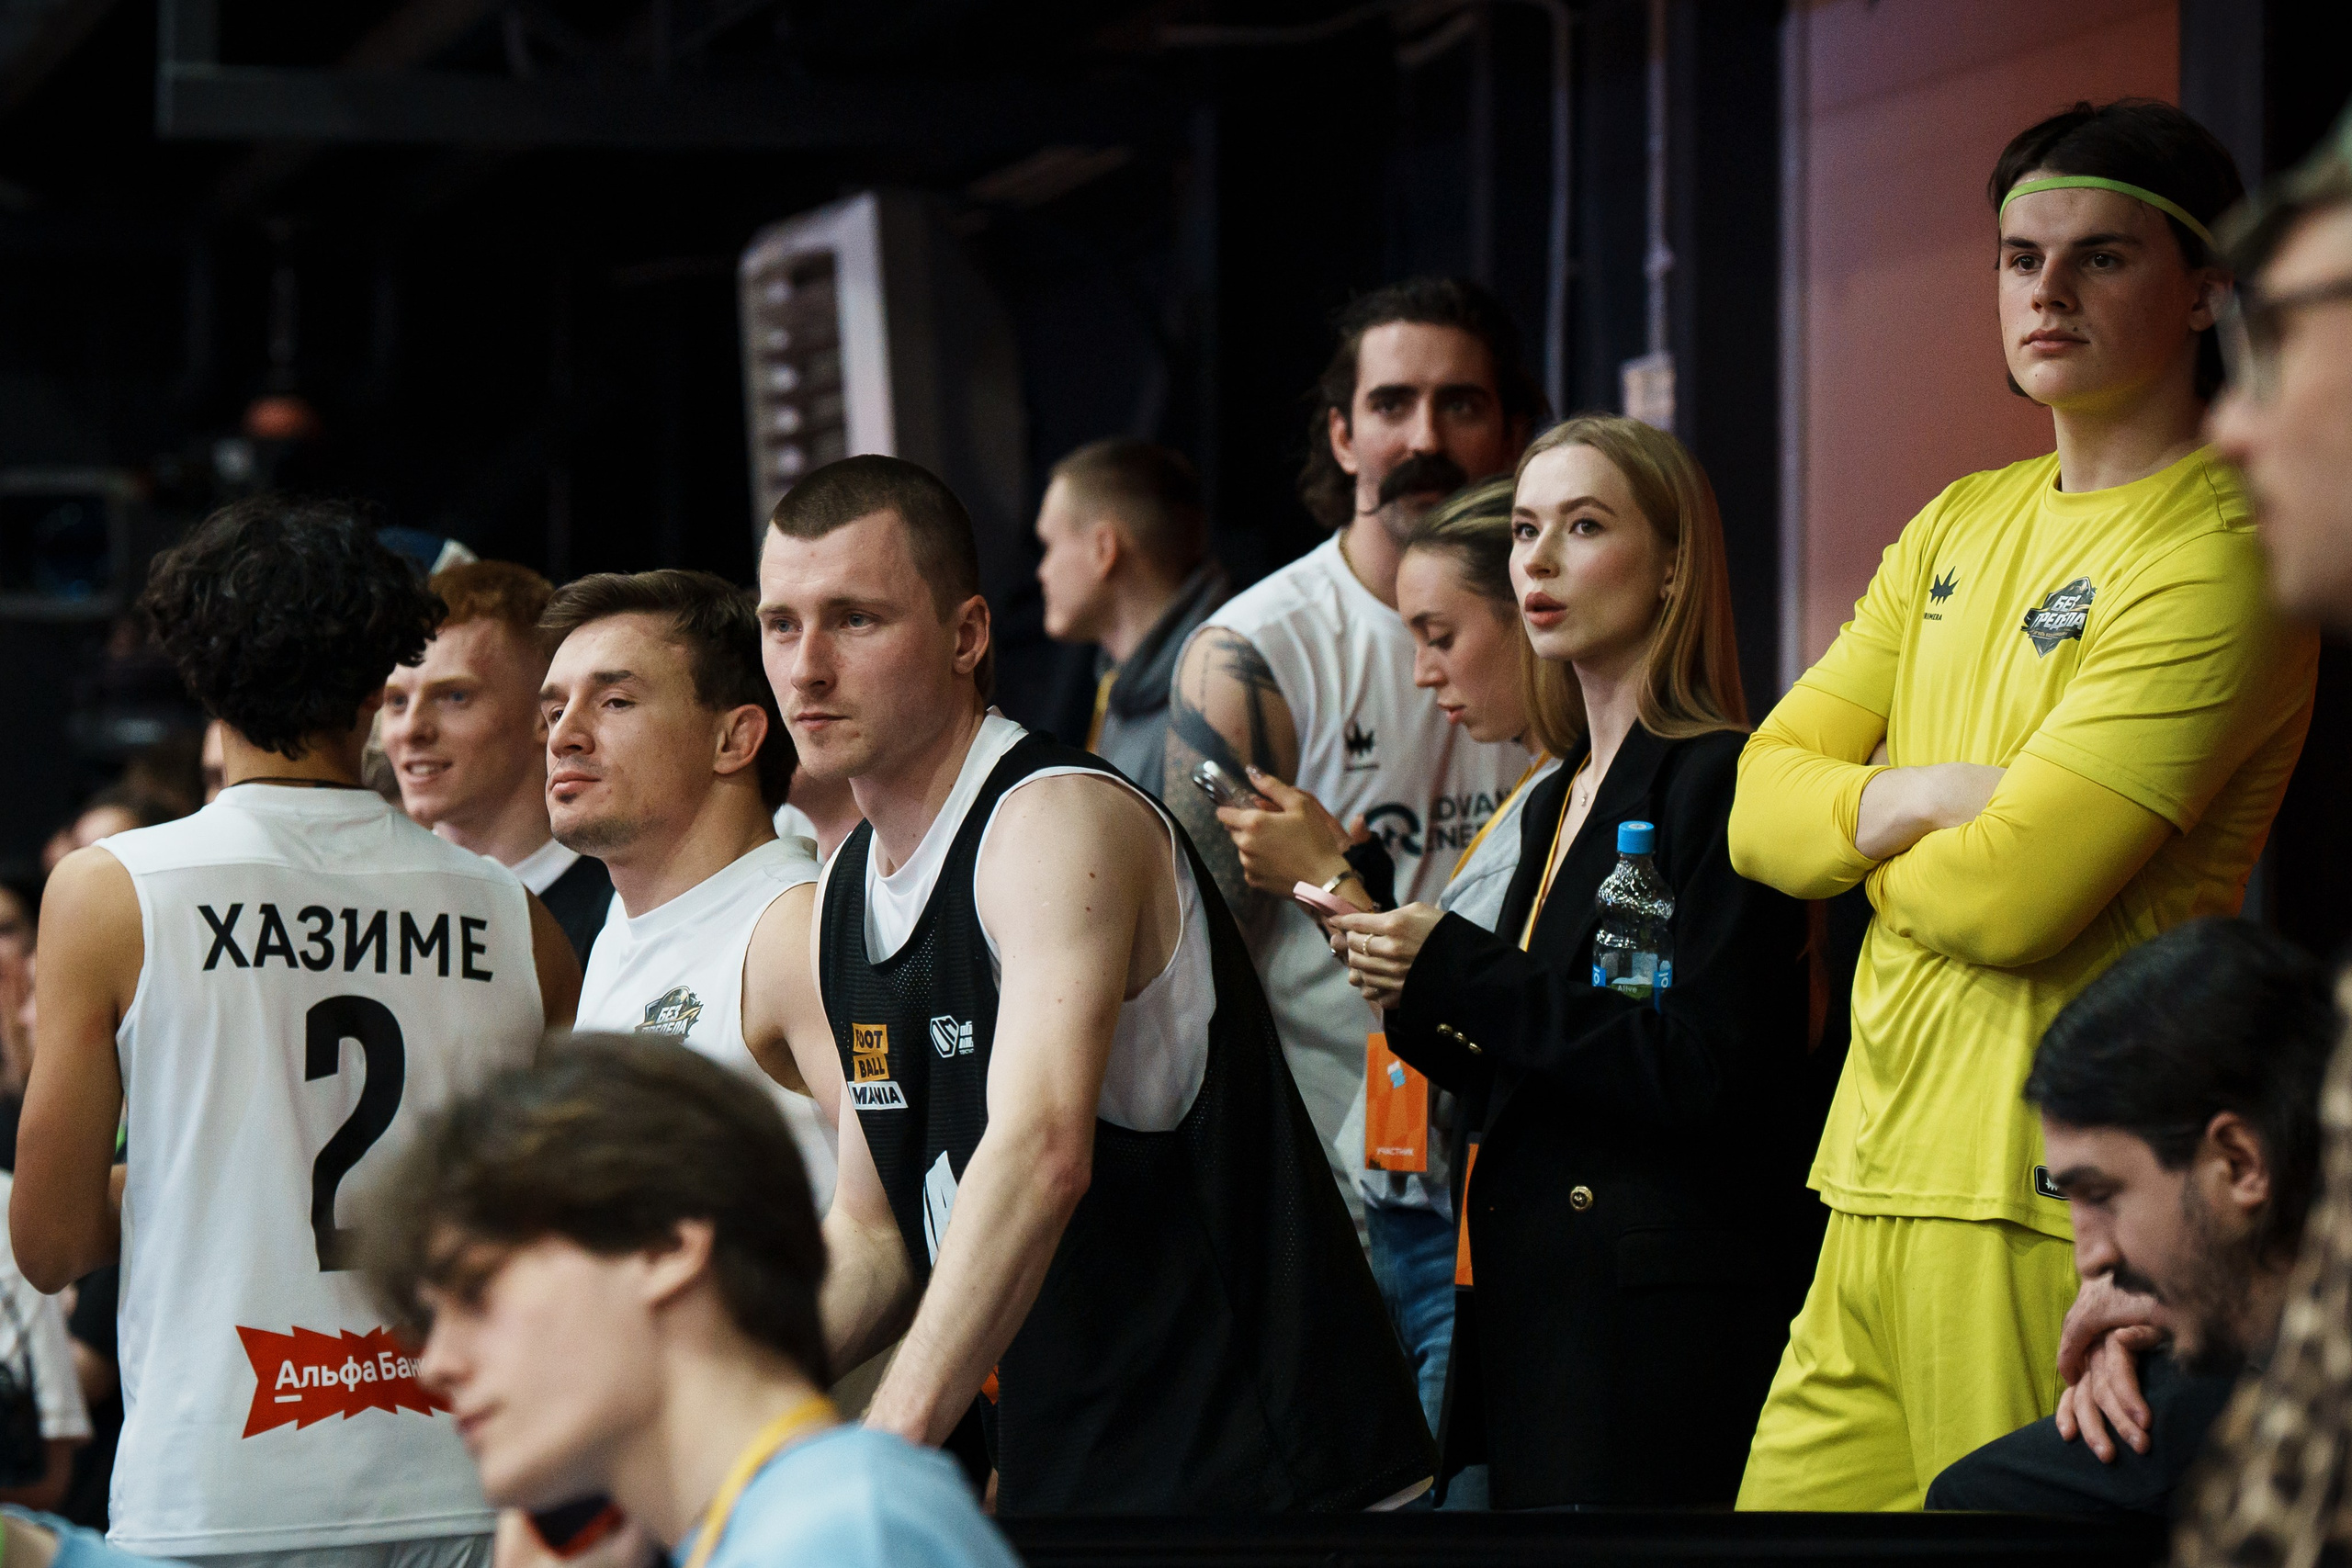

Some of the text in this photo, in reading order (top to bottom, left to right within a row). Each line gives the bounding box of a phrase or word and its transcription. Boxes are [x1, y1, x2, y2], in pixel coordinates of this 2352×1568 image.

[1923, 612, 1943, 621] RIMERA
[197, 903, 493, 983] ХАЗИМЕ
[854, 1028, 884, 1049] FOOT
[857, 1056, 886, 1078] BALL
[852, 1086, 902, 1105] MANIA
[304, 994, 406, 1273] 2
[275, 1355, 379, 1393] Альфа
